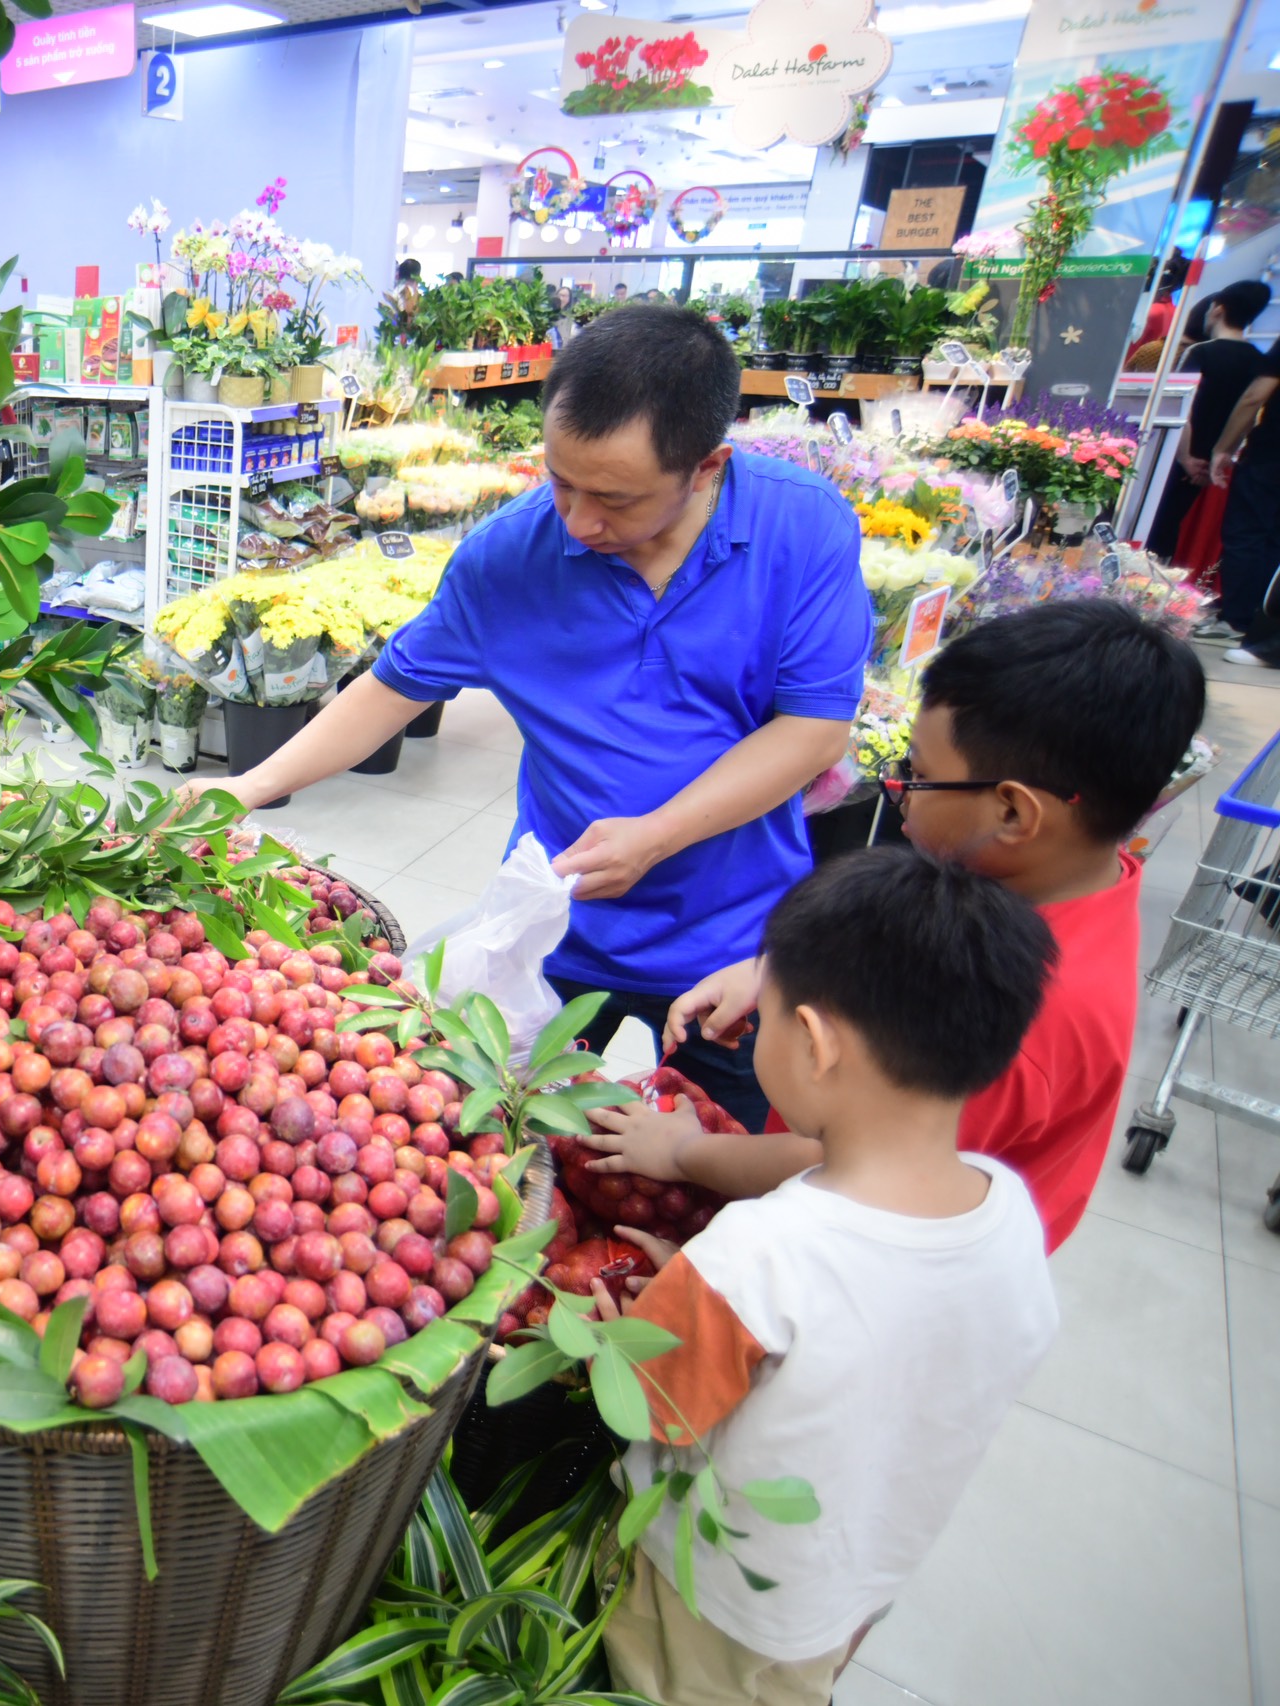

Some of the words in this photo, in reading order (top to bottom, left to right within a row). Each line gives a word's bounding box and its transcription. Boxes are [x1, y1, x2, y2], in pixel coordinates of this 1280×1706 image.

[33, 33, 56, 49] Quầy
[78, 25, 96, 39] tiền
[24, 52, 40, 67] sản
[42, 48, 67, 66] phẩm
[732, 58, 779, 80] Dalat
[156, 65, 170, 97] 2
[914, 198, 933, 209] THE
[907, 212, 935, 223] BEST
[896, 227, 939, 238] BURGER
[1056, 262, 1133, 275] Experiencing
